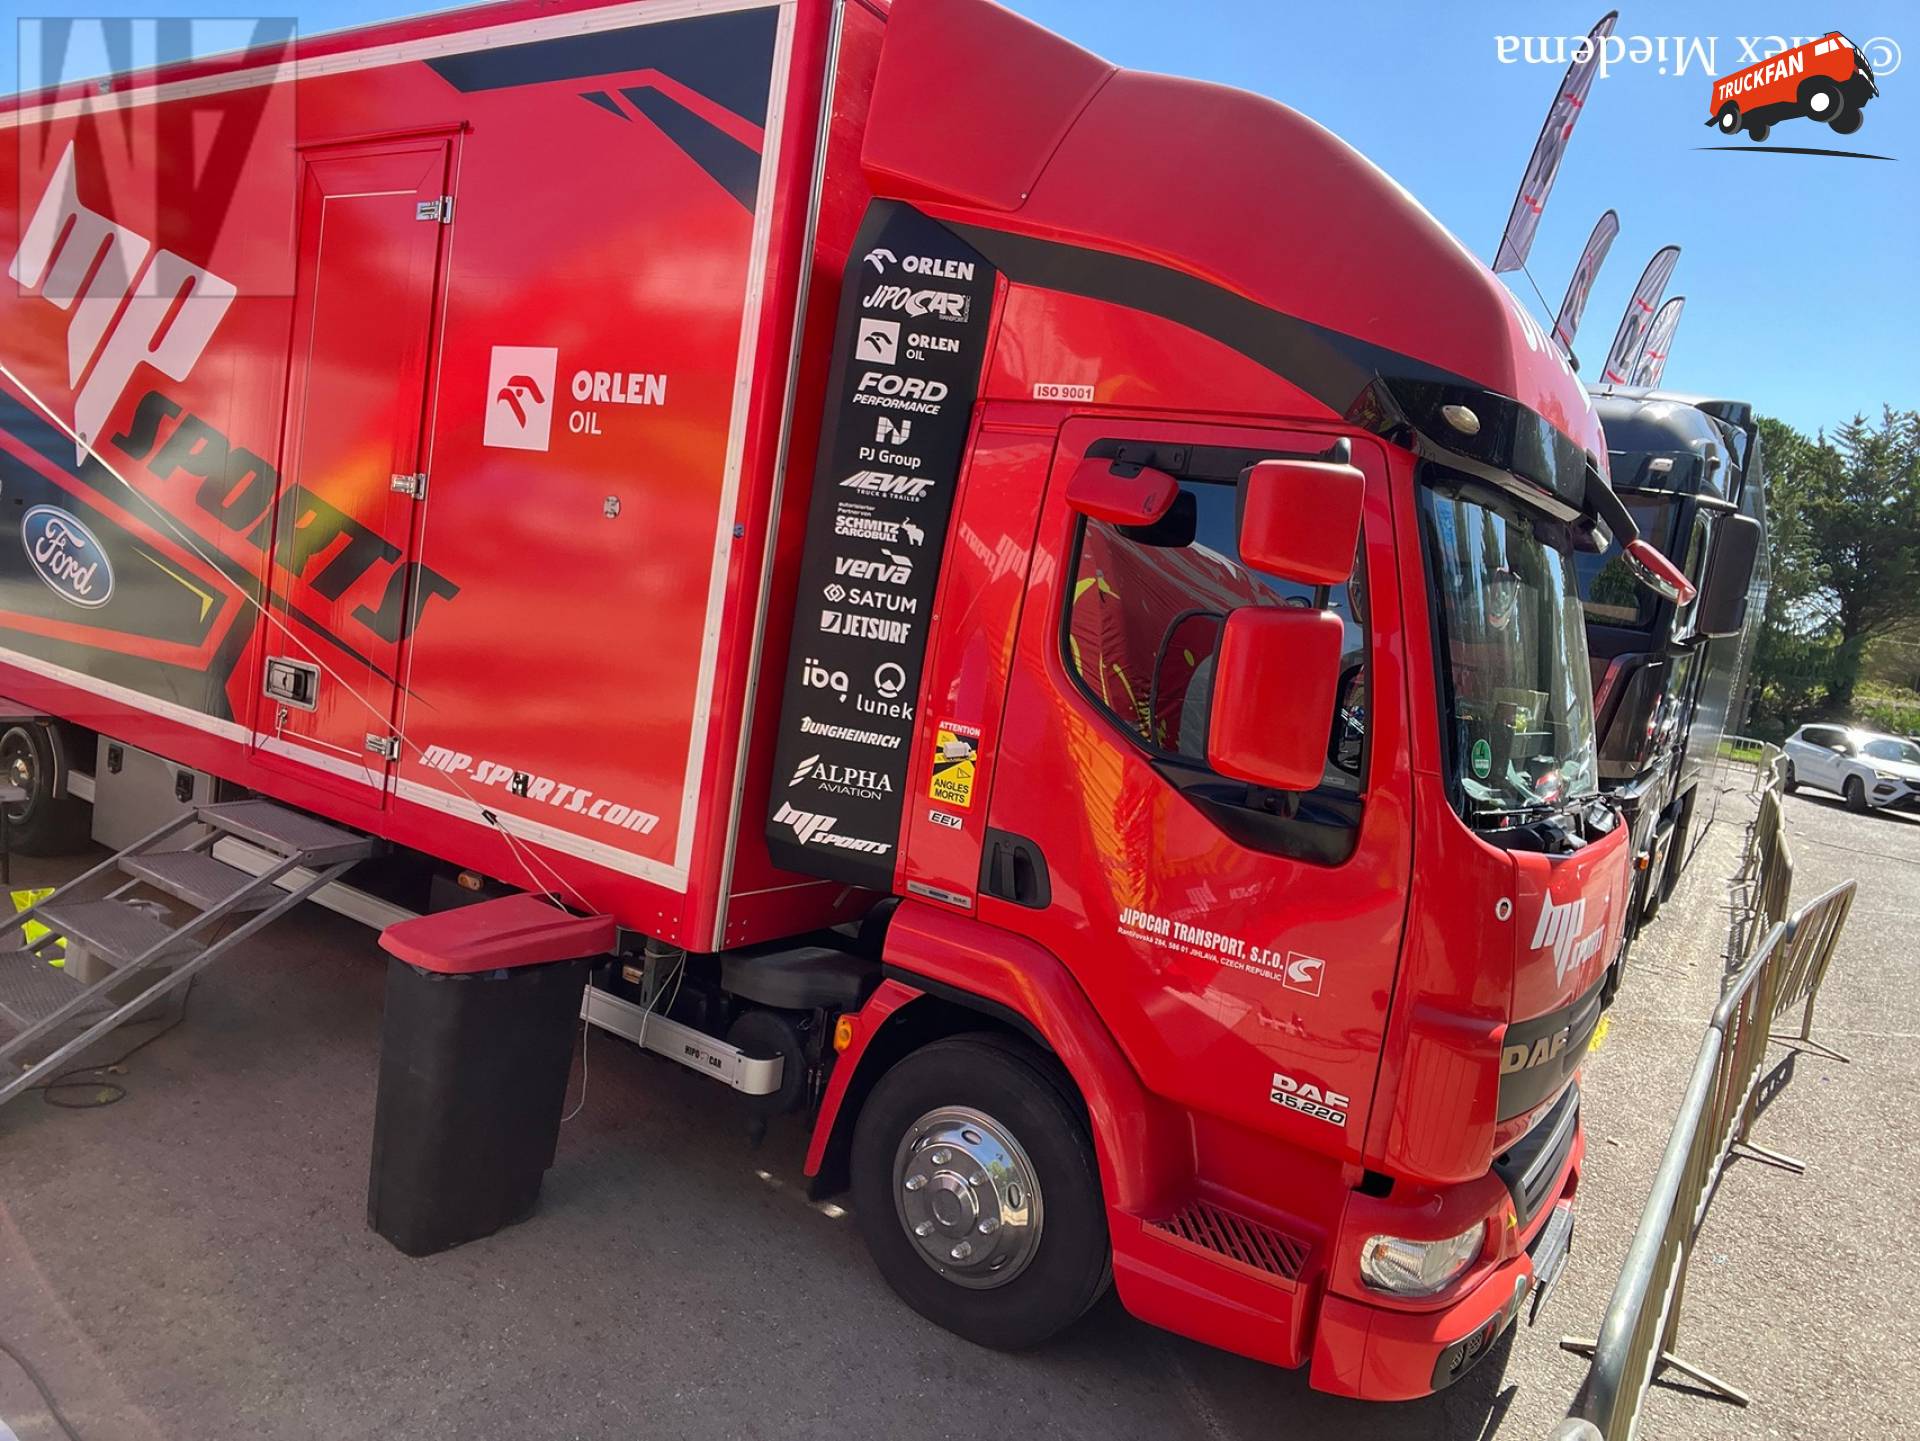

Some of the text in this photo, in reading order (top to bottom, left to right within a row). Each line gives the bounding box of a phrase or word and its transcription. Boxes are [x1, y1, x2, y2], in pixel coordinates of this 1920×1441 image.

[901, 255, 975, 281] ORLEN
[906, 349, 925, 361] OIL
[907, 333, 960, 353] ORLEN
[571, 370, 667, 406] ORLEN
[857, 371, 948, 402] FORD
[1037, 386, 1092, 399] ISO 9001
[852, 394, 941, 415] PERFORMANCE
[568, 410, 602, 435] OIL
[859, 447, 921, 471] PJ Group
[857, 488, 880, 497] TRUCK
[889, 493, 920, 503] TRAILER
[110, 390, 461, 644] SPORTS
[835, 515, 900, 534] SCHMITZ
[834, 526, 898, 543] CARGOBULL
[35, 514, 98, 597] Ford
[834, 556, 913, 585] verva
[848, 588, 917, 614] SATUM
[842, 614, 911, 645] JETSURF
[857, 693, 914, 720] lunek
[800, 716, 901, 749] JUNGHEINRICH
[939, 720, 981, 737] ATTENTION
[811, 762, 893, 792] ALPHA
[934, 778, 969, 793] ANGLES
[818, 782, 882, 800] AVIATION
[935, 787, 965, 804] MORTS
[931, 812, 960, 827] EEV
[809, 832, 892, 855] SPORTS
[1119, 907, 1171, 936] JIPOCAR
[1249, 946, 1284, 970] s.r.o.
[1220, 957, 1245, 970] CZECH
[1245, 964, 1282, 981] REPUBLIC
[1500, 1027, 1570, 1075] DAF
[1272, 1072, 1350, 1109] DAF
[1271, 1091, 1345, 1124] 45.220
